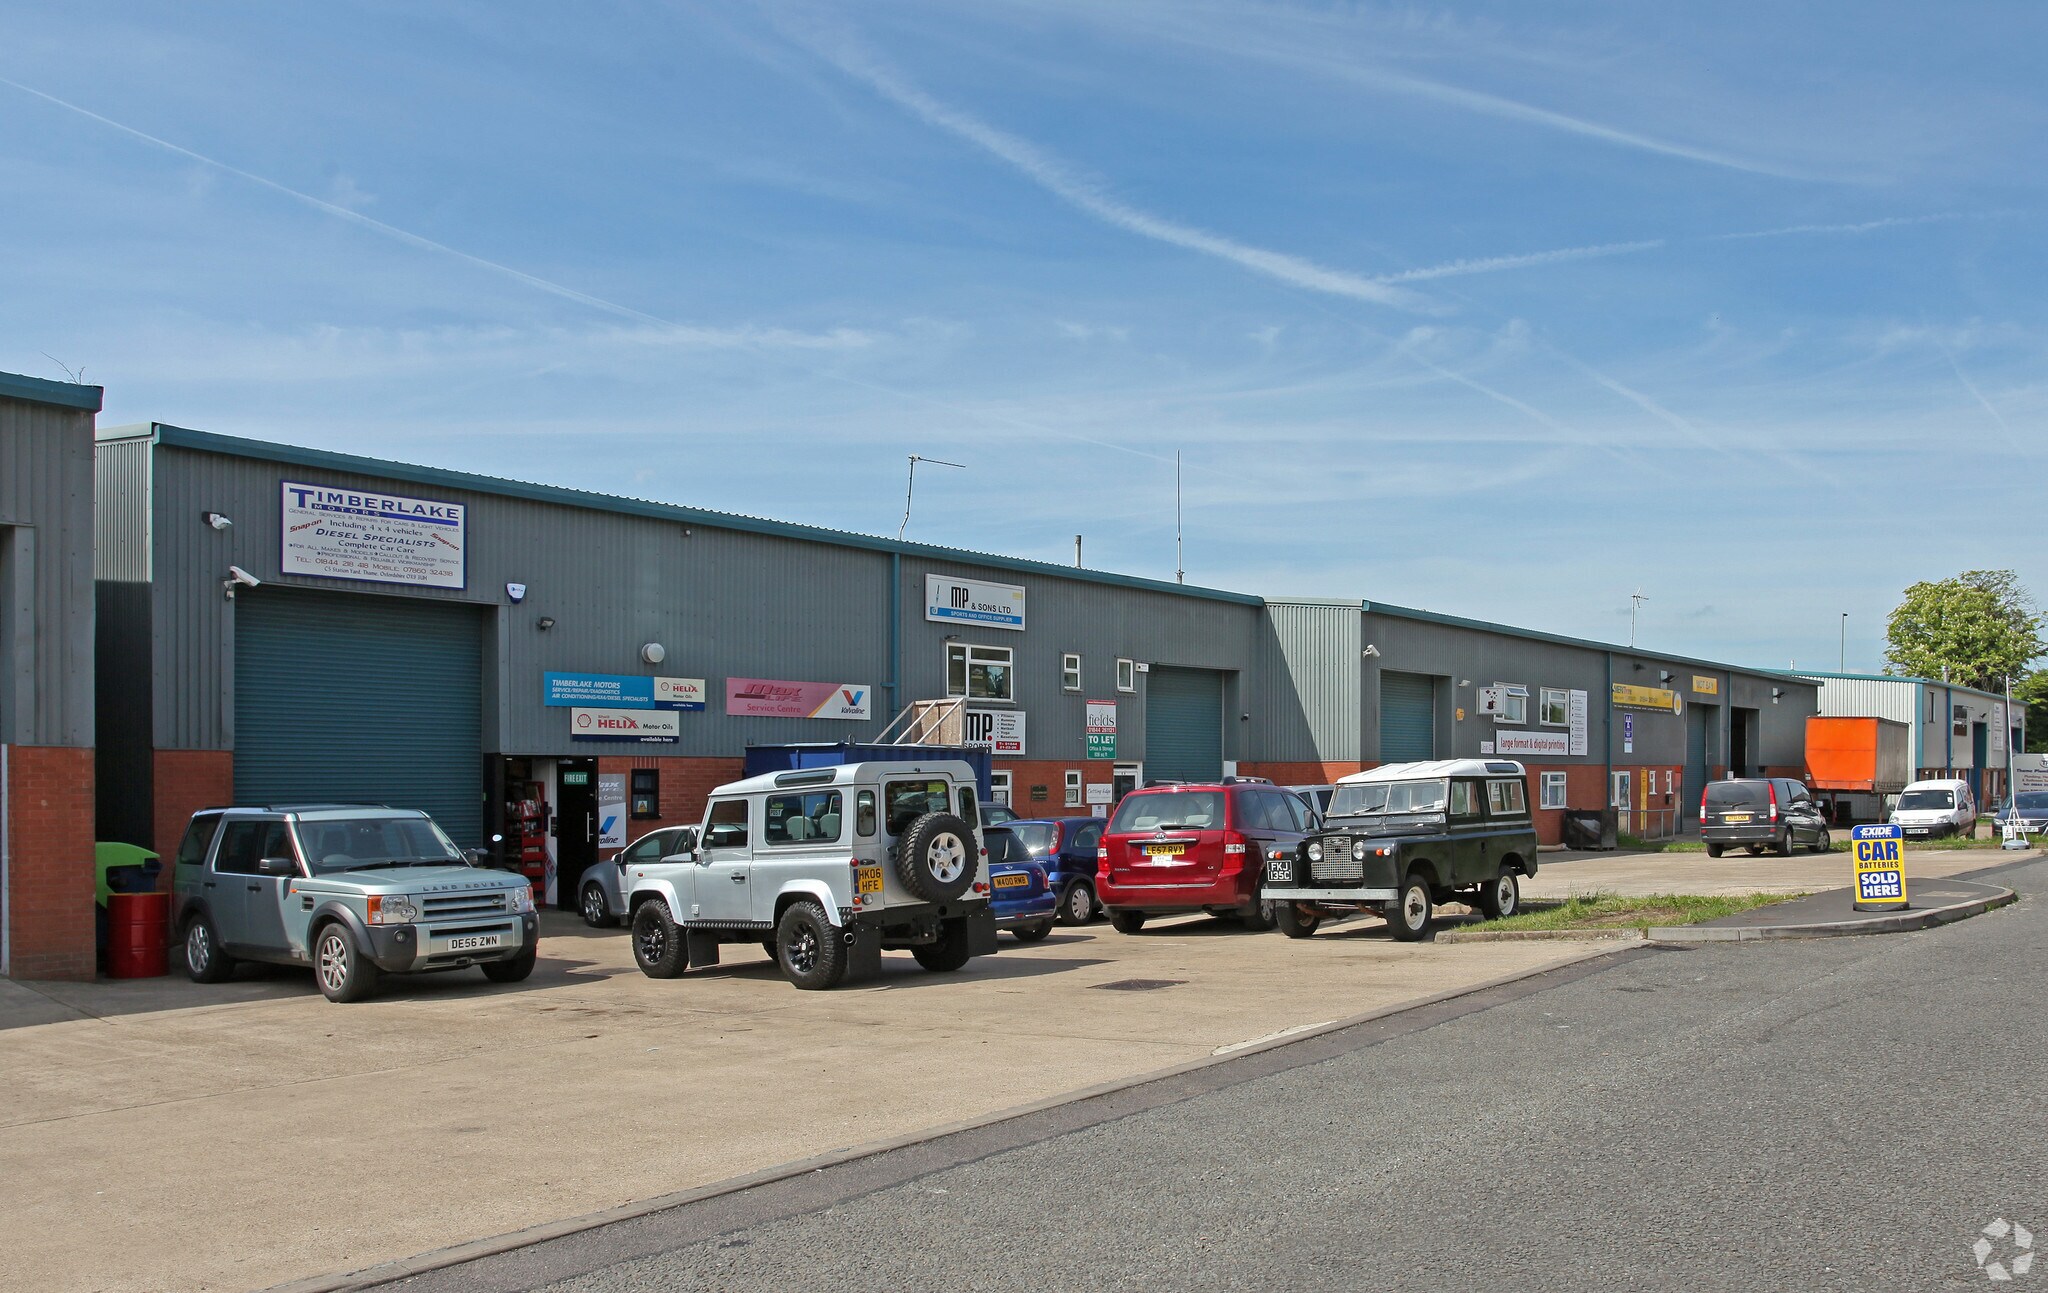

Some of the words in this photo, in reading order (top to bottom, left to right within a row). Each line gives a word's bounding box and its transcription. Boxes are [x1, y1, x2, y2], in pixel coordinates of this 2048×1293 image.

[289, 487, 459, 520] TIMBERLAKE
[314, 504, 381, 518] MOTORS
[330, 519, 367, 531] Including
[393, 527, 423, 536] vehicles
[316, 528, 359, 540] DIESEL
[363, 534, 436, 548] SPECIALISTS
[338, 539, 377, 551] Complete
[380, 544, 395, 552] Car
[396, 545, 415, 554] Care
[971, 602, 976, 610] &
[977, 603, 997, 613] SONS
[552, 679, 592, 688] TIMBERLAKE
[594, 681, 621, 690] MOTORS
[672, 683, 698, 694] HELIX
[746, 703, 775, 712] Service
[777, 704, 801, 713] Centre
[840, 706, 865, 715] Valvoline
[597, 717, 640, 730] HELIX
[1088, 713, 1115, 727] fields
[642, 723, 661, 731] Motor
[1088, 735, 1098, 744] TO
[1101, 735, 1115, 744] LET
[1501, 737, 1513, 751] large
[1513, 737, 1529, 749] format
[1533, 738, 1548, 751] digital
[1548, 740, 1566, 752] printing
[564, 774, 576, 783] FIRE
[576, 774, 588, 783] EXIT
[1861, 826, 1893, 836] EXIDE
[1168, 845, 1184, 854] RVX
[1857, 841, 1898, 862] CAR
[1271, 862, 1288, 871] FKJ
[1859, 861, 1899, 869] BATTERIES
[858, 868, 881, 880] HK06
[1270, 871, 1290, 880] 135C
[1860, 872, 1898, 885] SOLD
[423, 884, 458, 892] LAND
[465, 882, 505, 890] ROVER
[862, 880, 879, 891] HFE
[996, 878, 1014, 887] M400
[1862, 884, 1900, 897] HERE
[451, 937, 477, 949] DE56
[479, 935, 498, 946] ZWN
